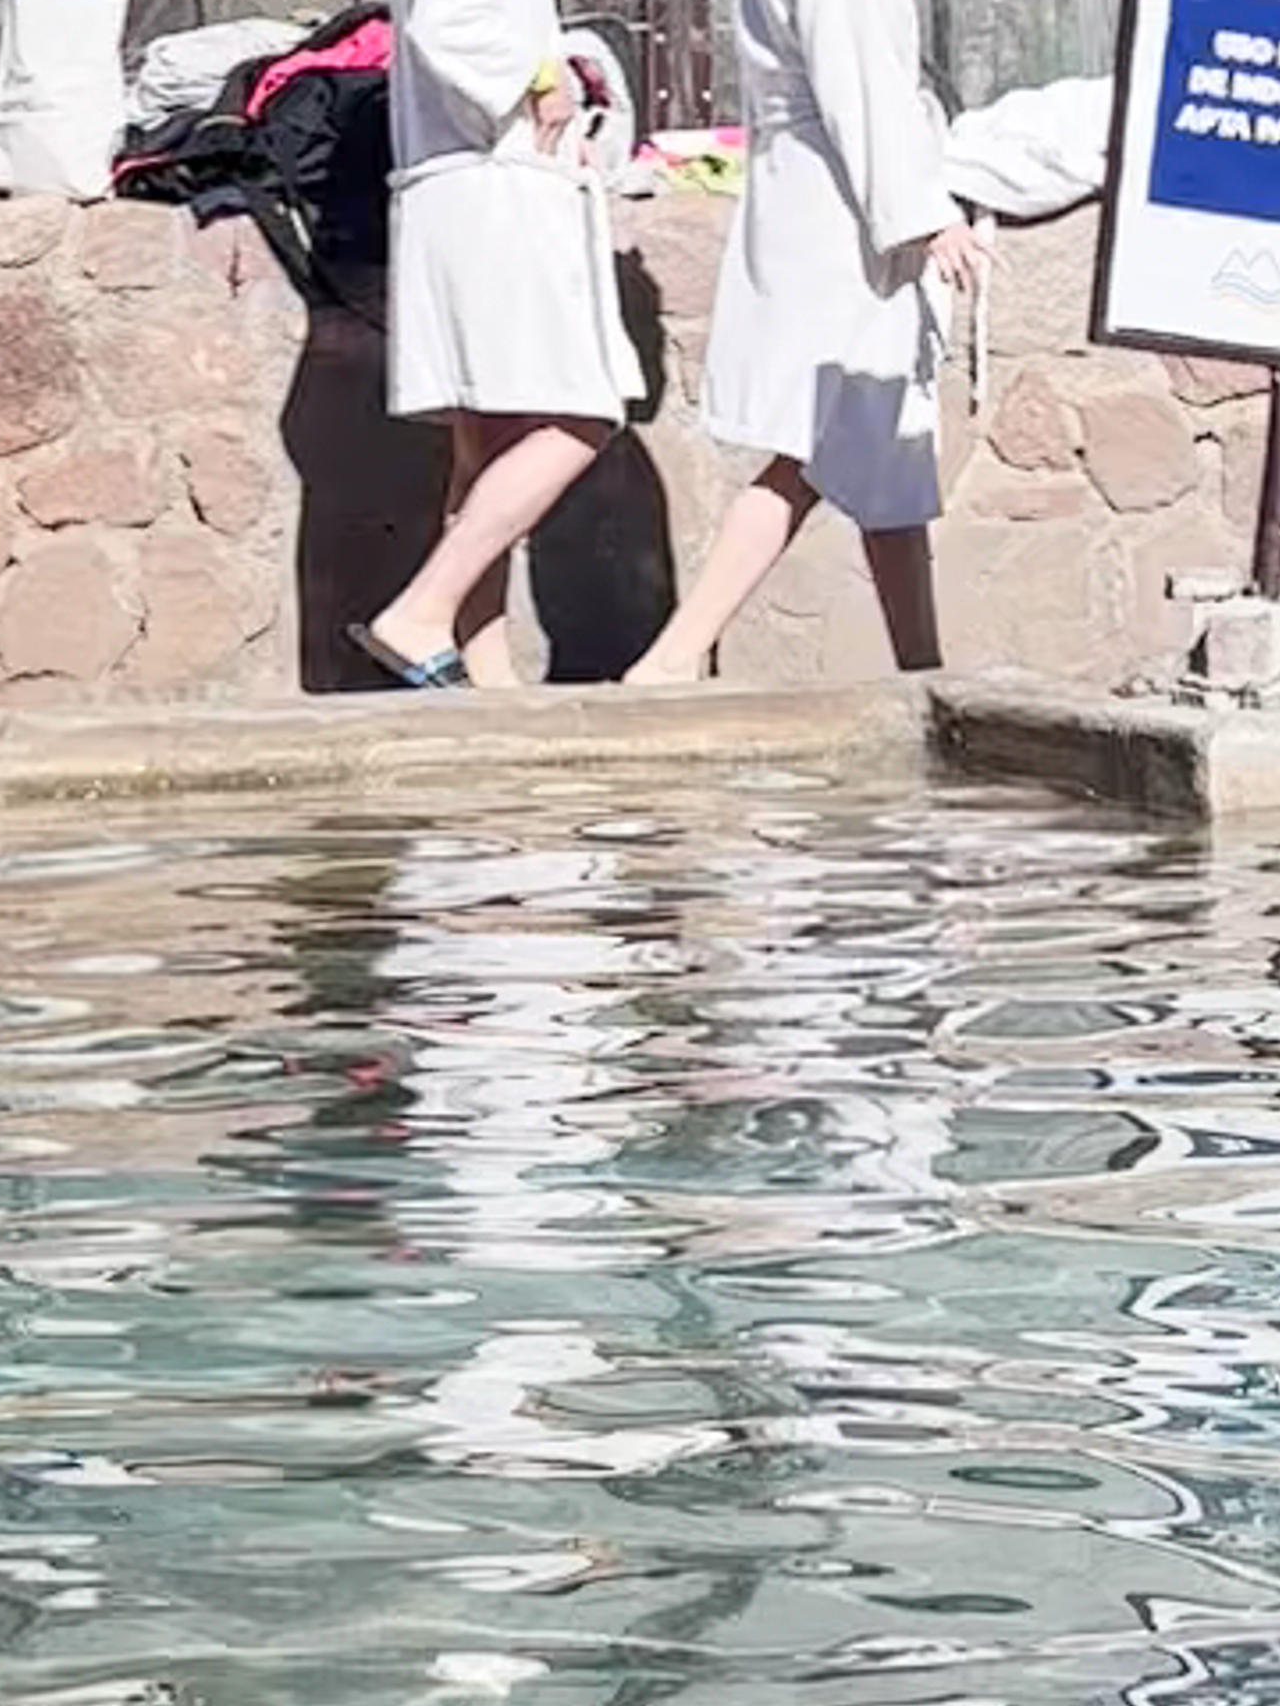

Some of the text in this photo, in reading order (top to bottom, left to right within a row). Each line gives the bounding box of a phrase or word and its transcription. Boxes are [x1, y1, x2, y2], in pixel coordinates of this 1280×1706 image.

[1214, 30, 1276, 66] USO
[1189, 65, 1229, 98] DE
[1174, 103, 1252, 140] APTA
